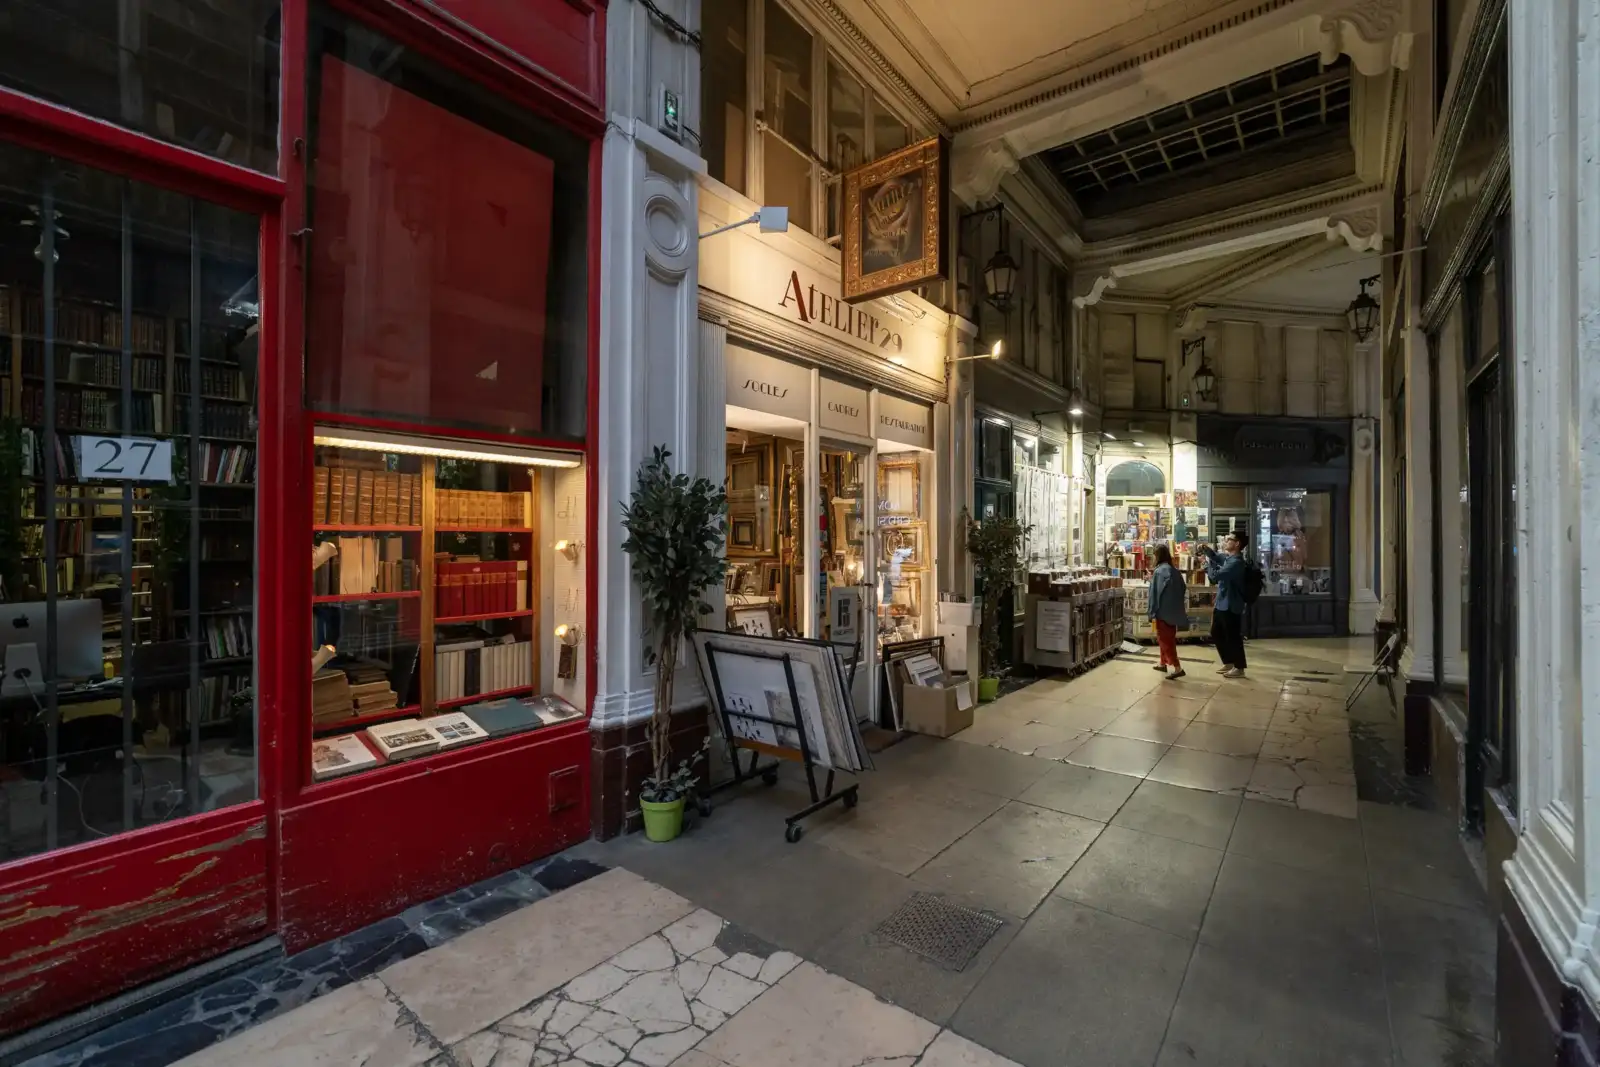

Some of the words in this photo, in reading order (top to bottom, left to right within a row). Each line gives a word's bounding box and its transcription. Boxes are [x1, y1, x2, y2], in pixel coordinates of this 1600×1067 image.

[879, 327, 903, 353] 29
[741, 379, 789, 399] SOCLES
[827, 401, 860, 418] CADRES
[94, 439, 157, 476] 27
